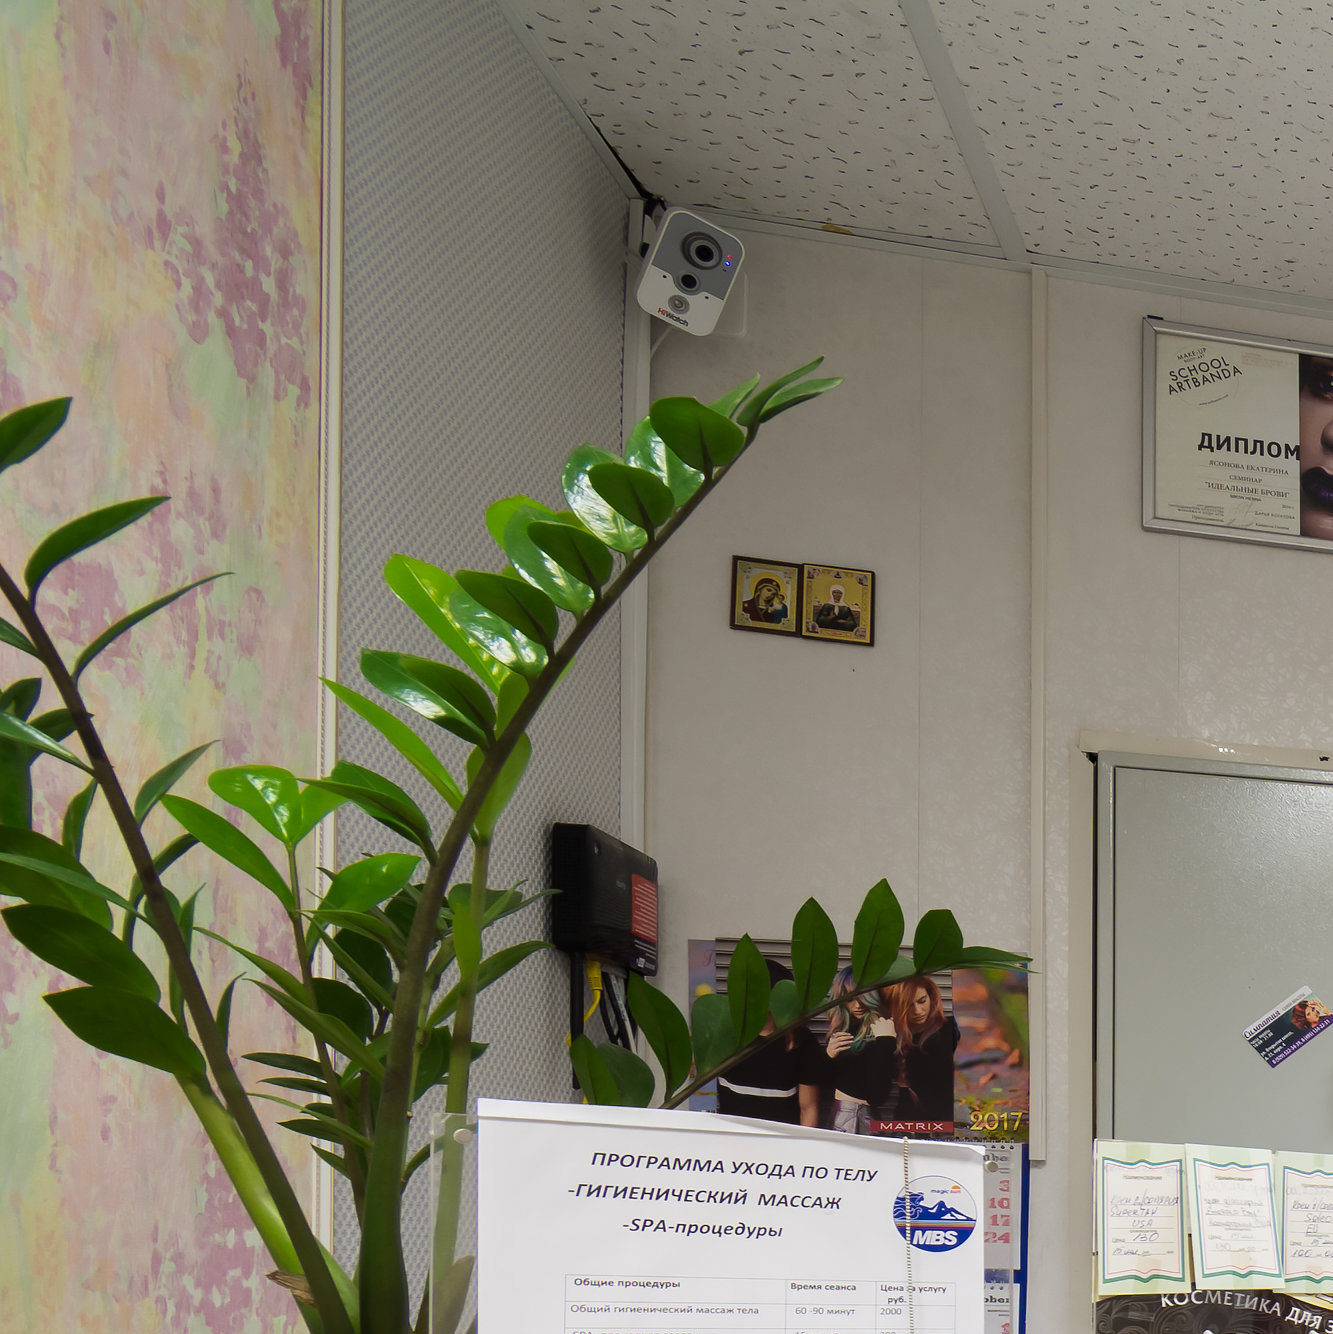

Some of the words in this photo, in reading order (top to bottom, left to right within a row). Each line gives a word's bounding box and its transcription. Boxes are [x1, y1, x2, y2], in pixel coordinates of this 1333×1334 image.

[1169, 356, 1230, 382] SCHOOL
[1168, 365, 1242, 395] ARTBANDA
[1197, 431, 1300, 461] ДИПЛОМ
[1246, 463, 1289, 476] ЕКАТЕРИНА
[1229, 475, 1263, 484] СЕМИНАР
[880, 1122, 944, 1131] MATRIX
[970, 1112, 1023, 1131] 2017
[591, 1152, 725, 1175] ПРОГРАММА
[730, 1160, 796, 1179] УХОДА
[801, 1164, 830, 1179] ПО
[834, 1167, 879, 1183] ТЕЛУ
[568, 1183, 748, 1206] -ГИГИЕНИЧЕСКИЙ
[757, 1192, 843, 1211] МАССАЖ
[622, 1217, 784, 1239] -SPA-процедуры
[912, 1230, 959, 1246] MBS
[574, 1278, 614, 1287] Общие
[617, 1280, 681, 1289] процедуры
[790, 1282, 822, 1291] Время
[880, 1284, 904, 1293] Цена
[918, 1286, 947, 1294] услугу
[614, 1305, 692, 1315] гигиенический
[696, 1307, 734, 1315] массаж
[880, 1308, 902, 1316] 2000
[1160, 1291, 1281, 1317] КОСМЕТИКА
[1285, 1306, 1323, 1330] ДЛЯ
